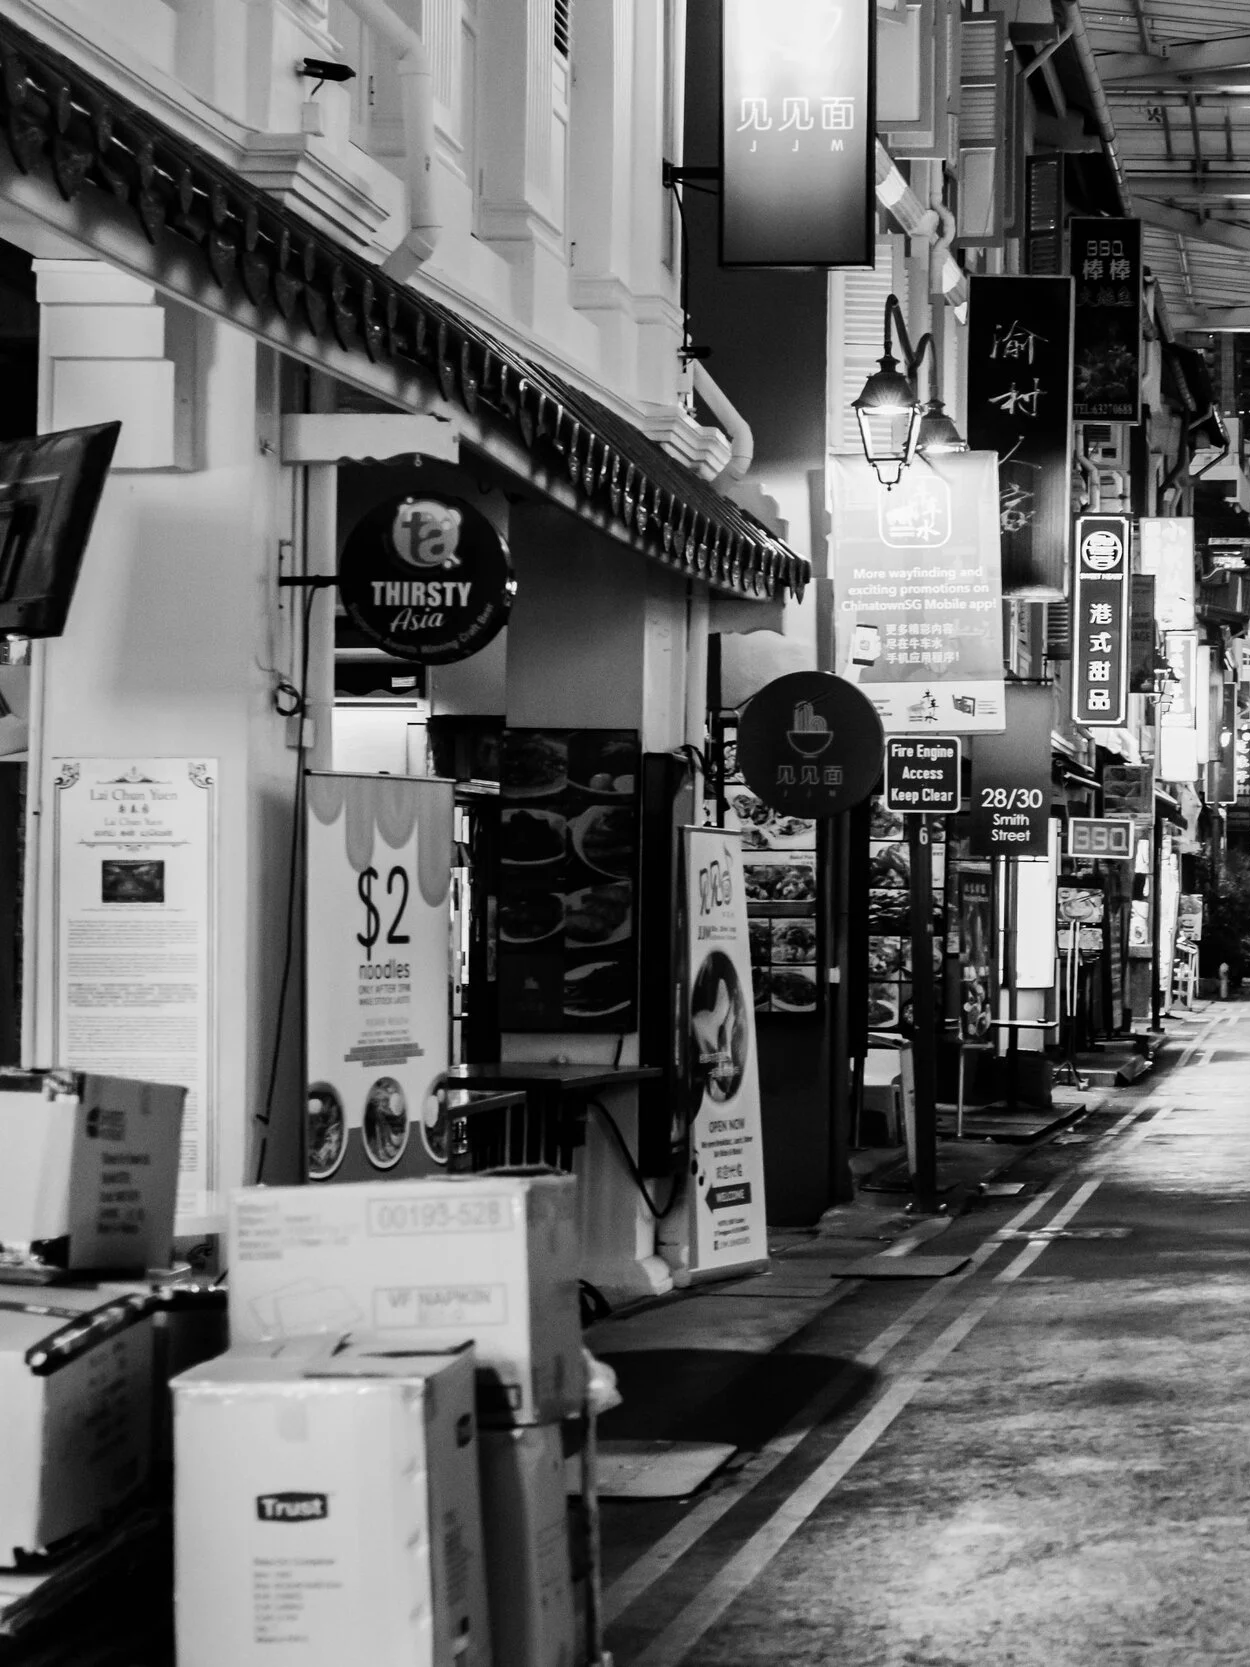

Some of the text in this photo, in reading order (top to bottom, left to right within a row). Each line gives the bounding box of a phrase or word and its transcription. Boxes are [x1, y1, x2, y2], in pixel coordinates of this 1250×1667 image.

[736, 96, 856, 132] 见见面
[853, 566, 984, 582] More wayfinding and
[370, 581, 472, 607] THIRSTY
[848, 582, 990, 598] exciting promotions on
[841, 598, 998, 613] ChinatownSG Mobile app!
[390, 607, 445, 633] Asia
[1088, 603, 1113, 711] 港式甜品
[891, 743, 954, 761] Fire Engine
[776, 765, 843, 785] 见见面
[902, 766, 943, 780] Access
[90, 788, 178, 801] Lai Chun Yuen
[890, 788, 954, 804] Keep Clear
[981, 788, 1043, 810] 28/30
[992, 813, 1030, 826] Smith
[991, 829, 1031, 842] Street
[1074, 825, 1128, 851] BBQ
[356, 865, 410, 962] $2
[358, 958, 410, 980] noodles
[708, 1117, 745, 1134] OPEN NOW
[377, 1201, 501, 1231] 00193-528
[261, 1497, 323, 1517] Trust
